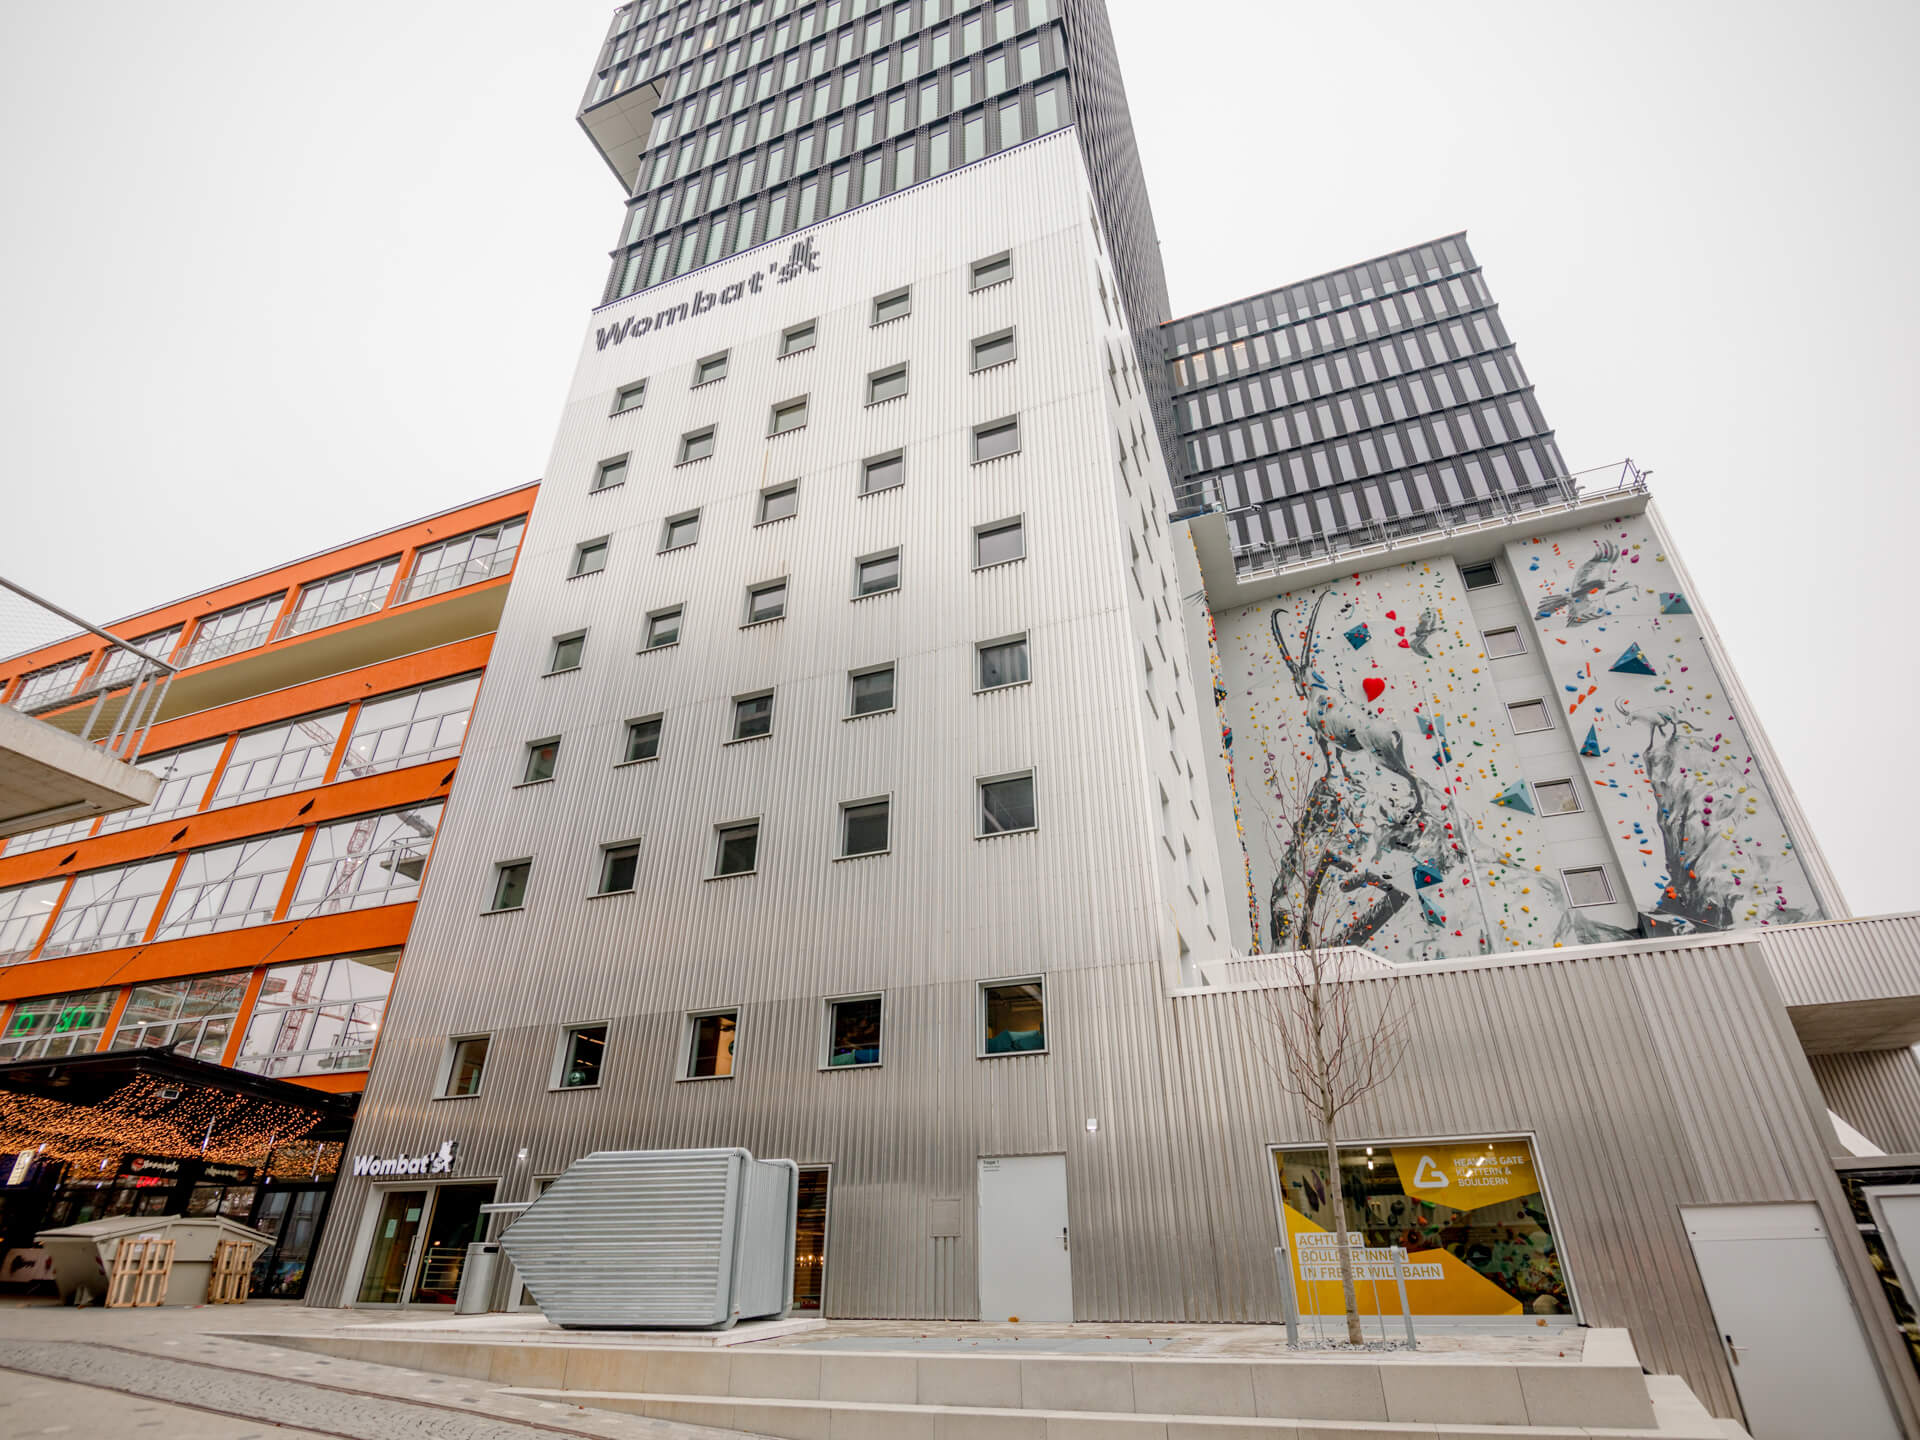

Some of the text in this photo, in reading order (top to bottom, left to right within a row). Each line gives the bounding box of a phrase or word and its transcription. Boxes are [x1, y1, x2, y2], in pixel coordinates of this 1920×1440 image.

[596, 260, 798, 352] Wombat's
[353, 1152, 445, 1176] Wombat's
[1454, 1155, 1525, 1167] HEAVNS GATE
[1456, 1167, 1512, 1177] KLTTERN &
[1458, 1177, 1509, 1187] BOULDERN
[1299, 1234, 1361, 1246] ACHTUG!
[1304, 1266, 1317, 1278] IN
[1320, 1266, 1364, 1278] FRER
